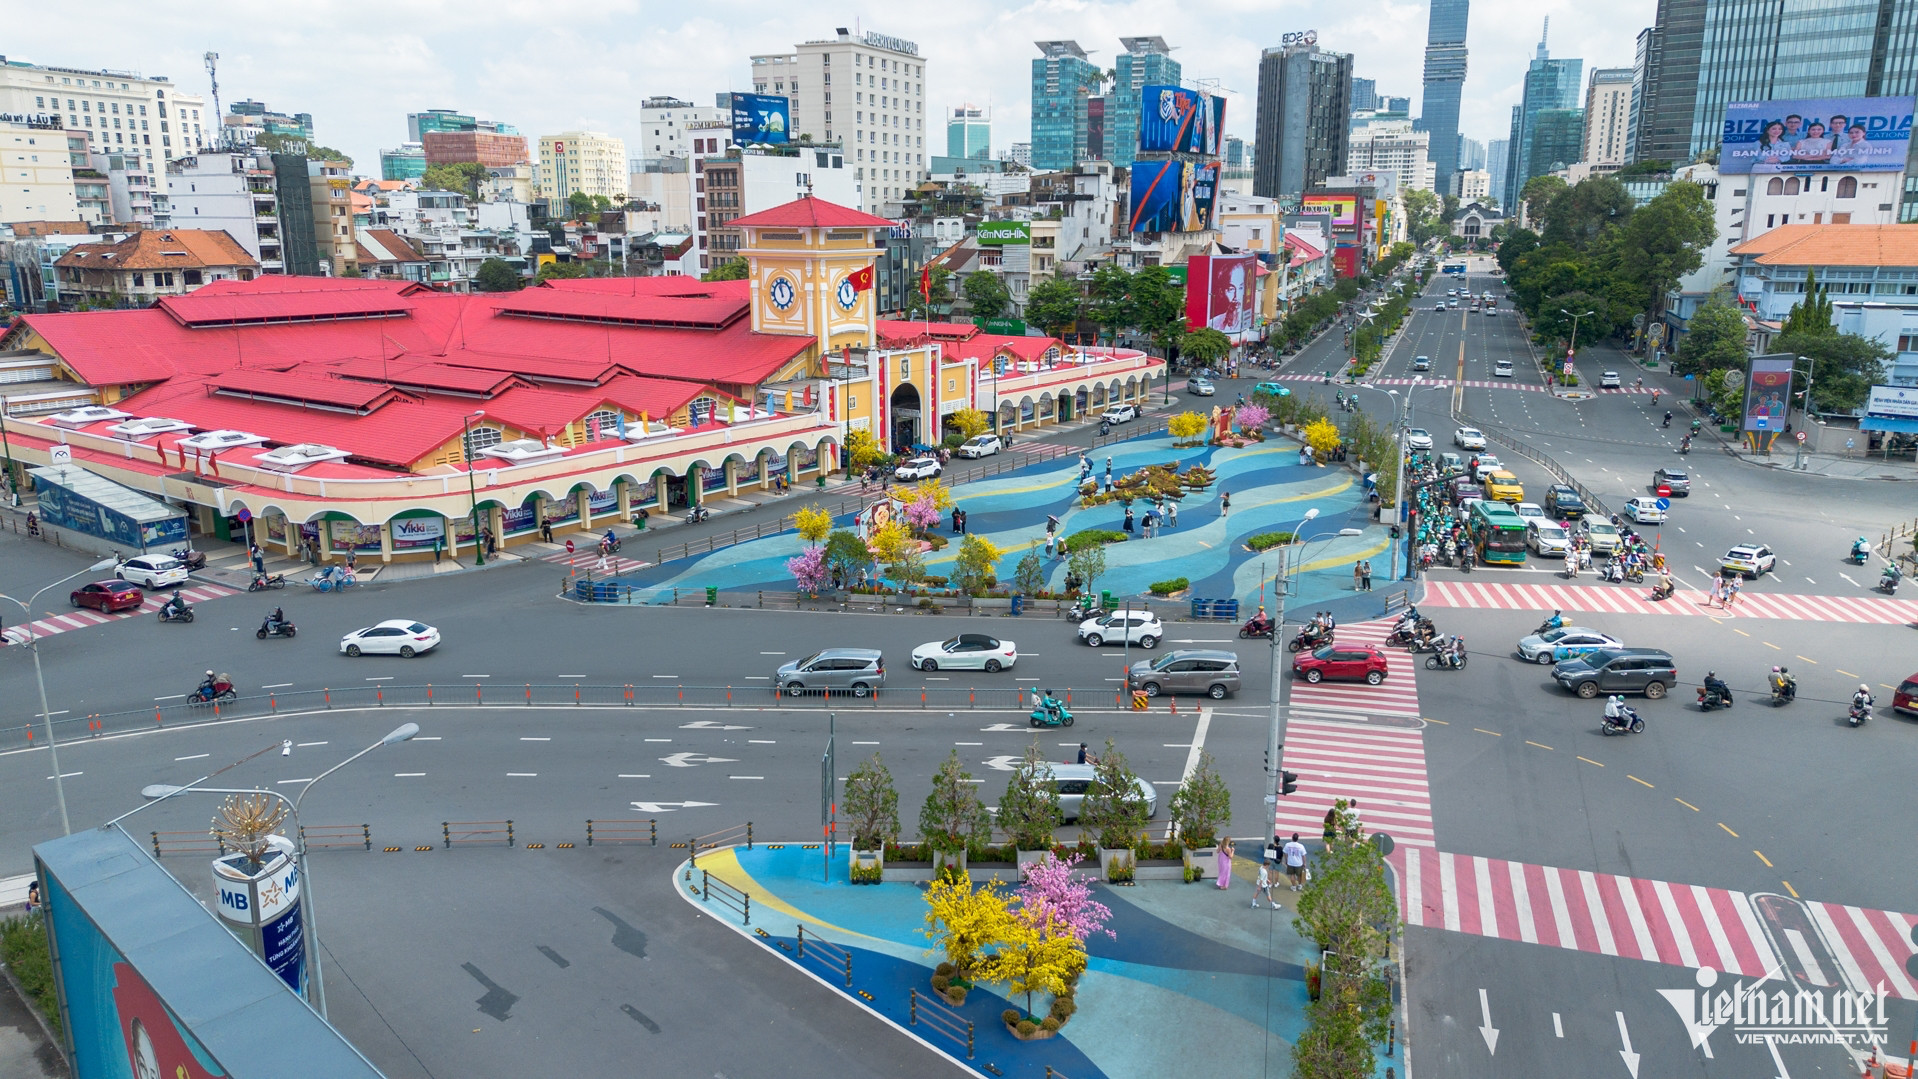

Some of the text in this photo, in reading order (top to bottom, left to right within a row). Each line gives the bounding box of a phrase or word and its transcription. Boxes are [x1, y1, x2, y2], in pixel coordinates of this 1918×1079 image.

[1732, 150, 1759, 158] BẠN
[1762, 147, 1807, 156] KHÔNG
[1280, 205, 1331, 213] KING LUXURY
[502, 508, 523, 519] Vikki
[398, 520, 425, 533] Vikki
[221, 888, 249, 910] MB
